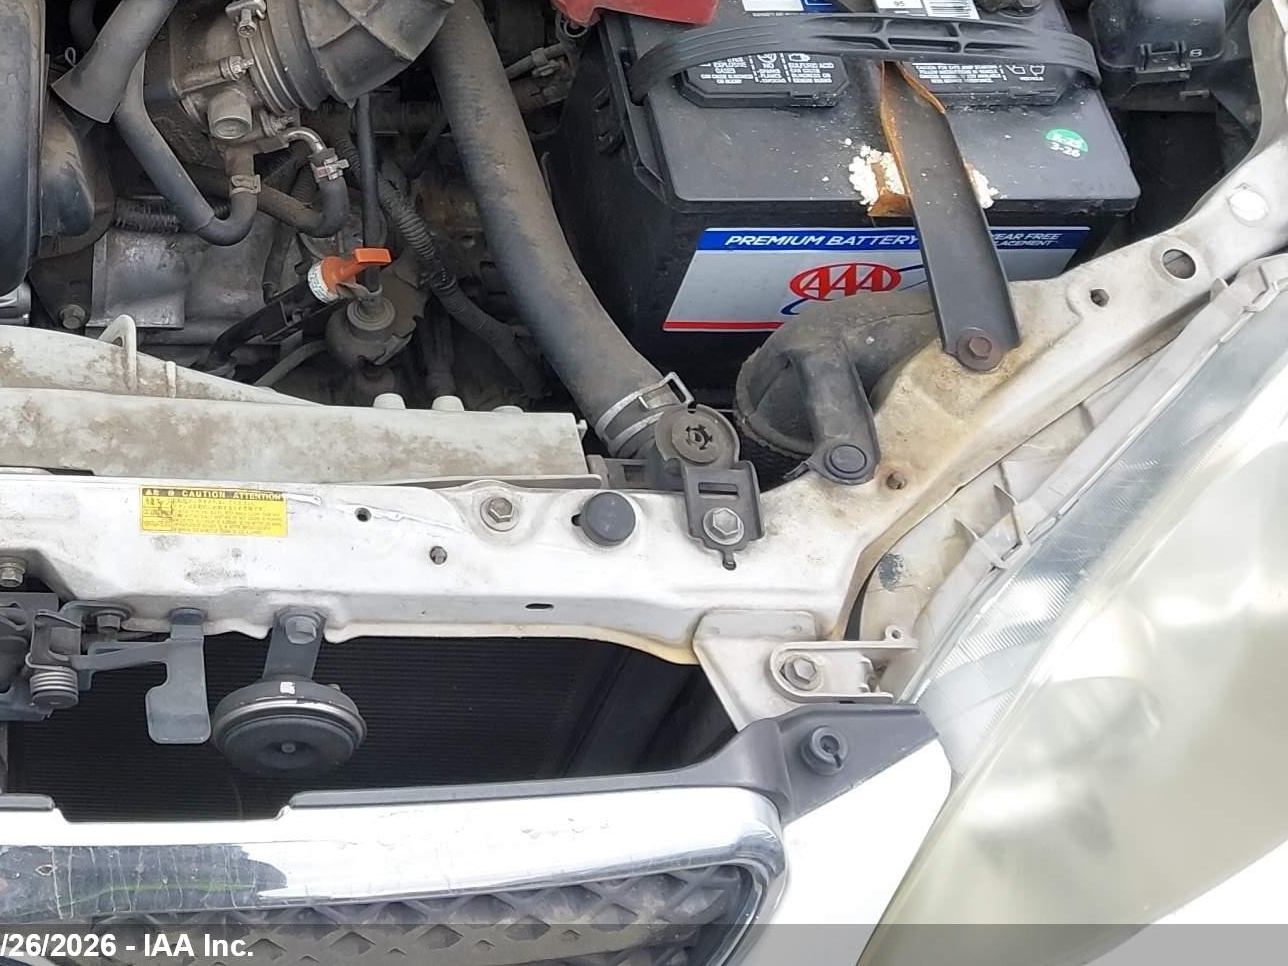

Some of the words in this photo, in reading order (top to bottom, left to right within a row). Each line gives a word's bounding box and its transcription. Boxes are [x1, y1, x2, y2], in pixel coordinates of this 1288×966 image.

[893, 0, 905, 8] 95
[725, 234, 826, 247] PREMIUM
[825, 234, 920, 247] BATTERY
[793, 262, 896, 301] AAA
[181, 490, 226, 499] CAUTION
